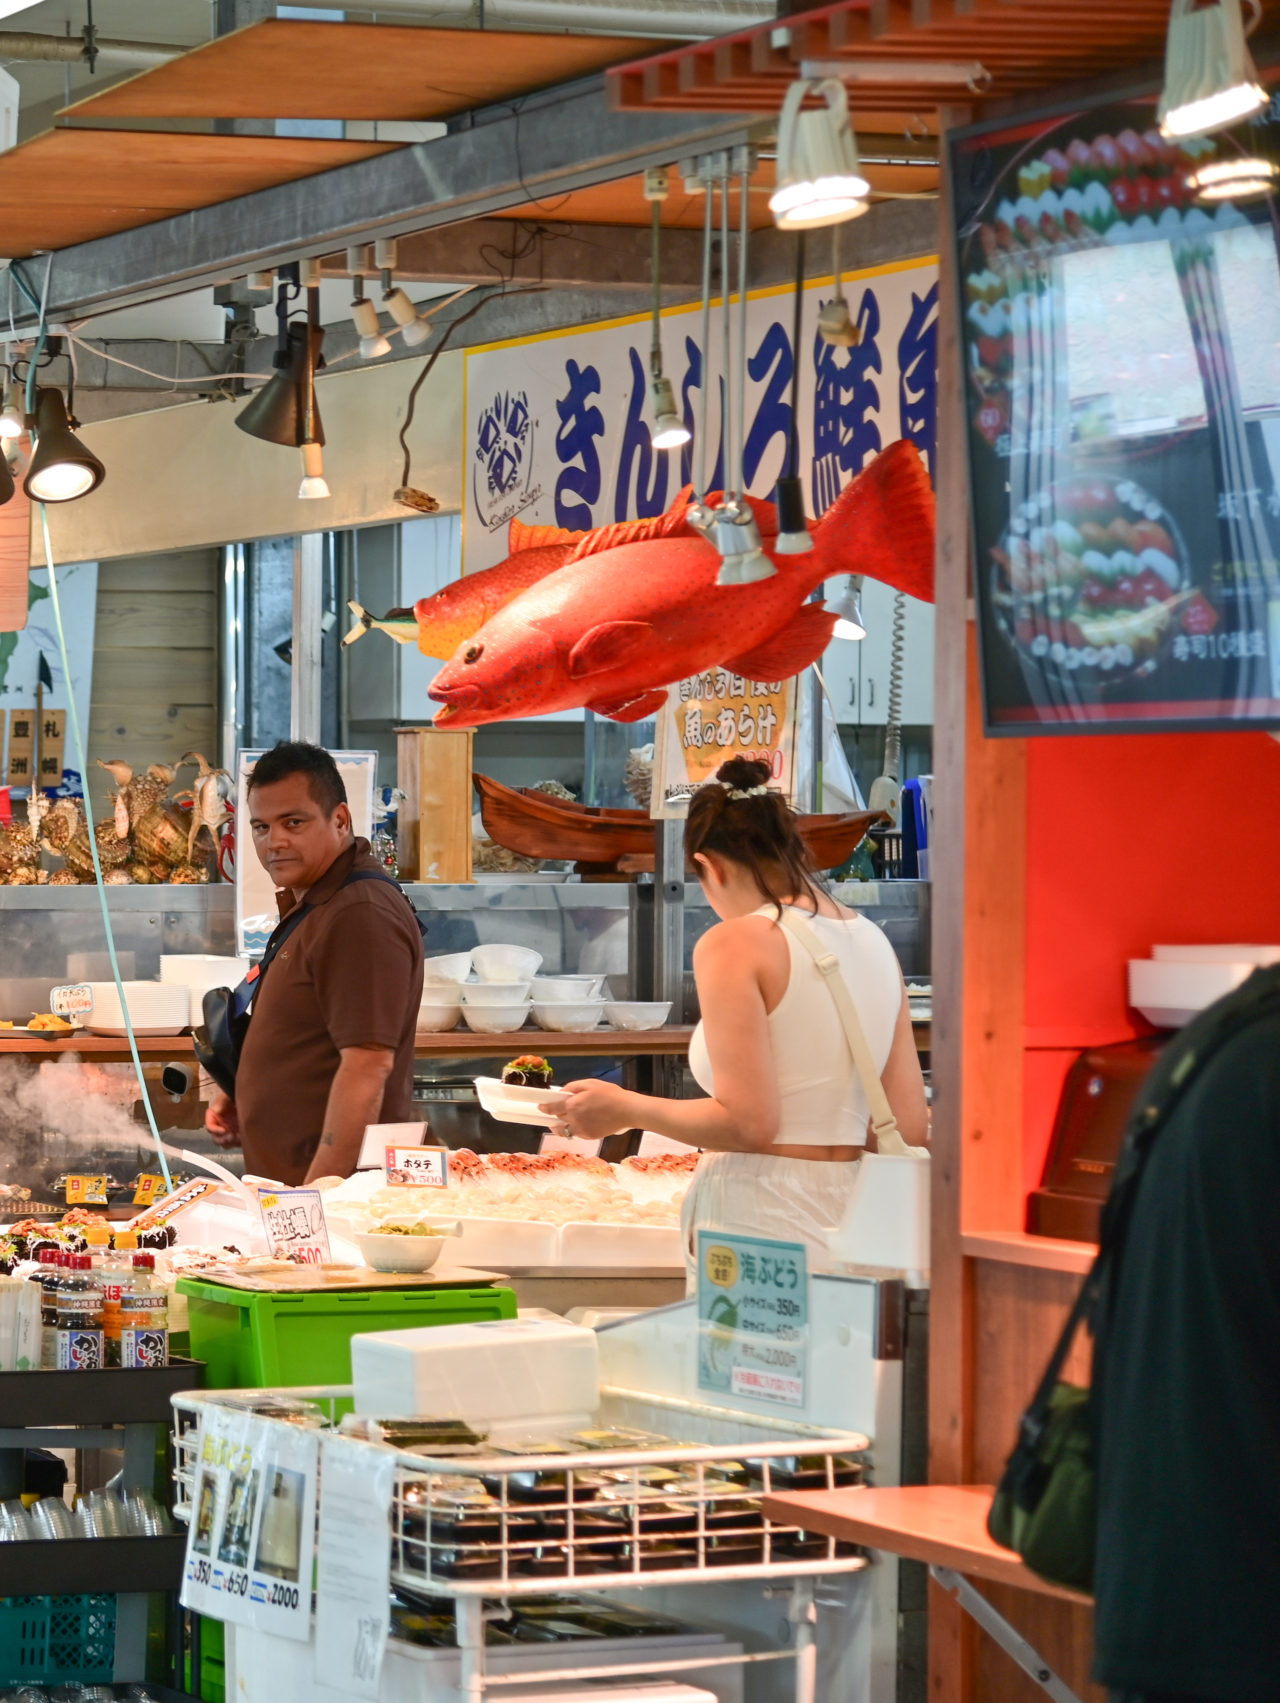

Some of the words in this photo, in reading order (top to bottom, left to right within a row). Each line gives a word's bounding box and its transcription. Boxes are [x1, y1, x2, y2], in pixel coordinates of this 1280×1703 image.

[683, 703, 778, 748] 魚のあら汁
[403, 1158, 433, 1170] ホタテ
[740, 1252, 799, 1290] 海ぶどう
